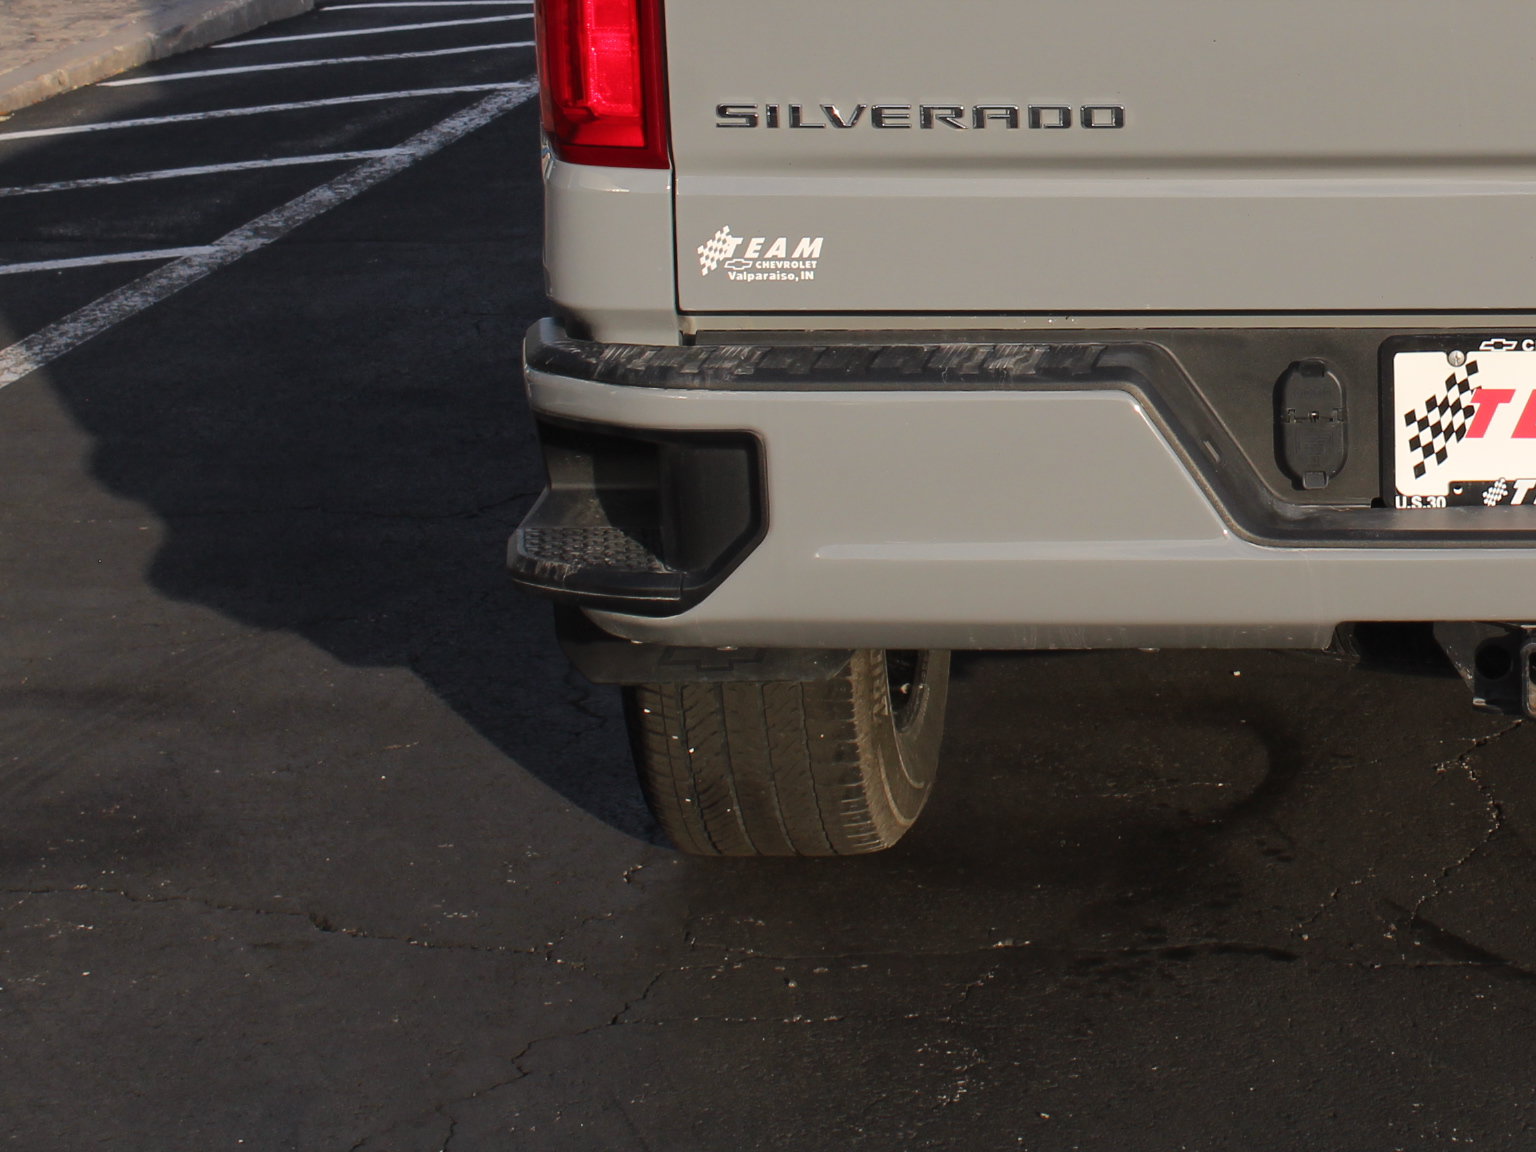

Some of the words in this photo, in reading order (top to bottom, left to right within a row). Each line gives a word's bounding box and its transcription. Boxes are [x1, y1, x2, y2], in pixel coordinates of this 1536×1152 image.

[715, 102, 1127, 130] SILVERADO
[723, 236, 824, 259] TEAM
[755, 260, 818, 269] CHEVROLET
[728, 270, 799, 282] Valparaiso,
[800, 270, 814, 280] IN
